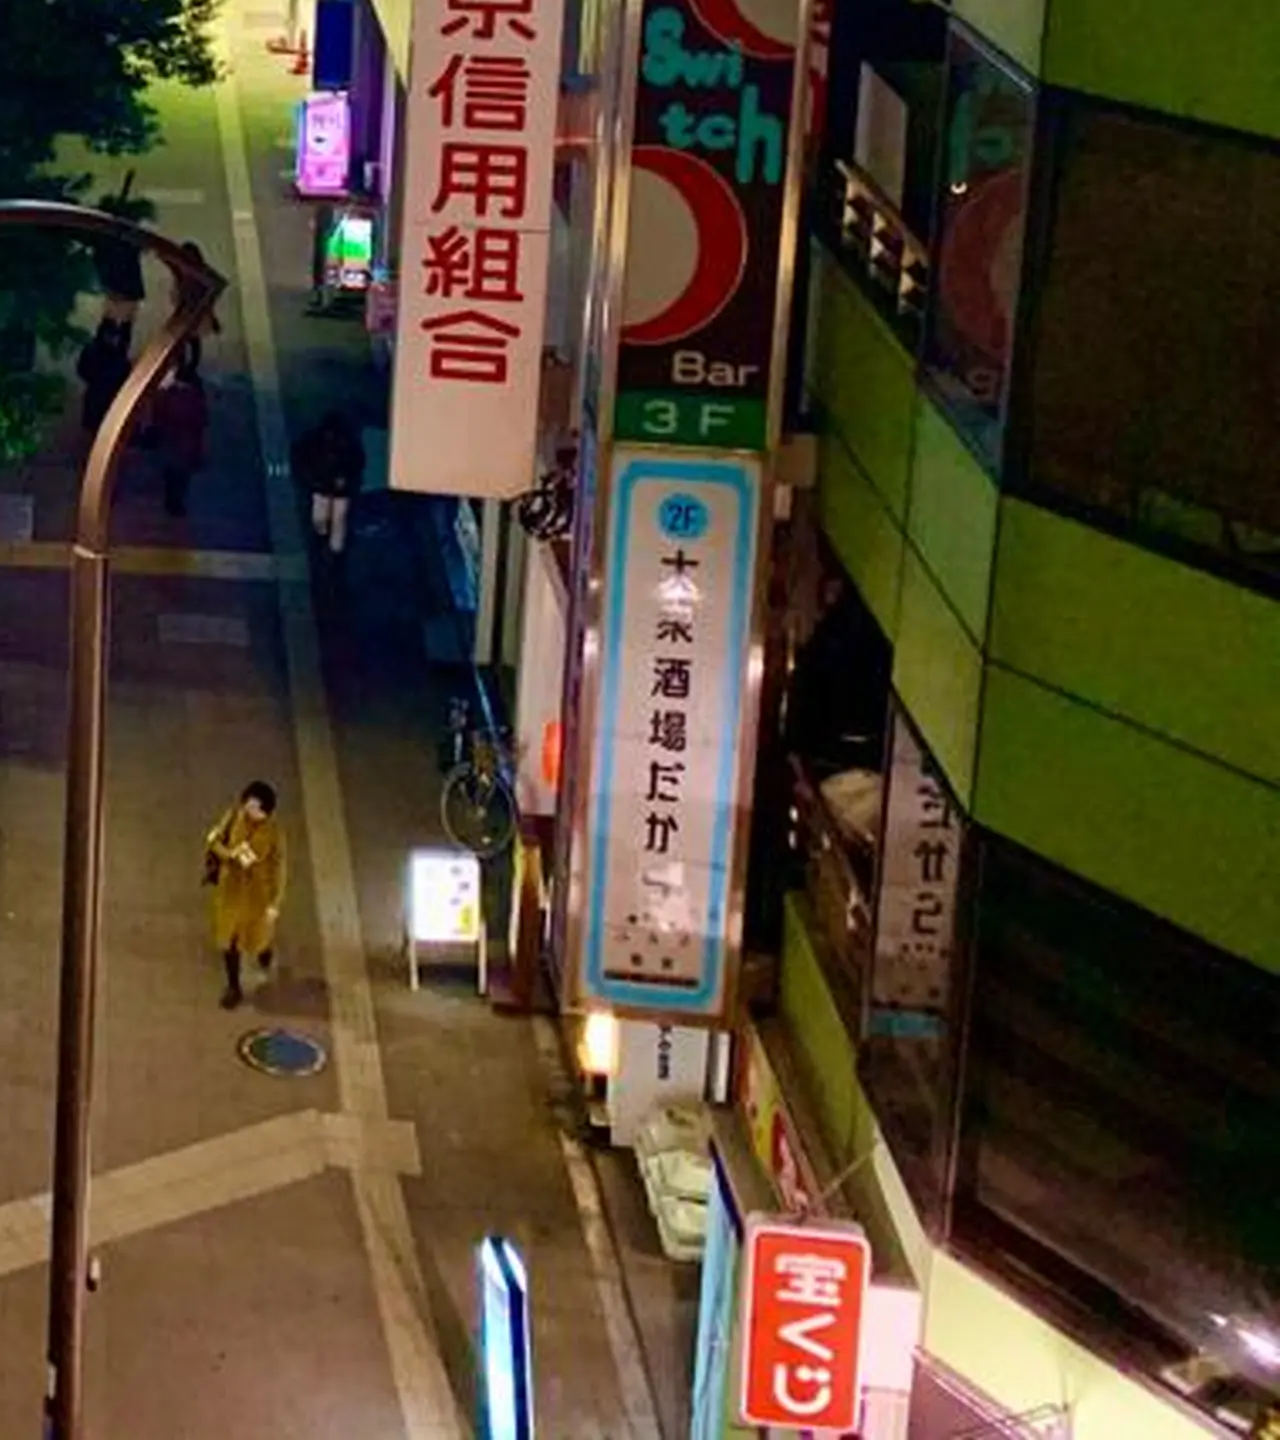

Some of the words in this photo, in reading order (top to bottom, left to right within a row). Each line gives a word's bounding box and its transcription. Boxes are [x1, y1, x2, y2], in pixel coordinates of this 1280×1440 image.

[658, 82, 786, 186] tch
[671, 350, 759, 388] Bar
[642, 398, 735, 437] 3F
[667, 503, 698, 534] 2F
[642, 549, 700, 905] 大酒場だか
[773, 1250, 847, 1416] 宝くじ
